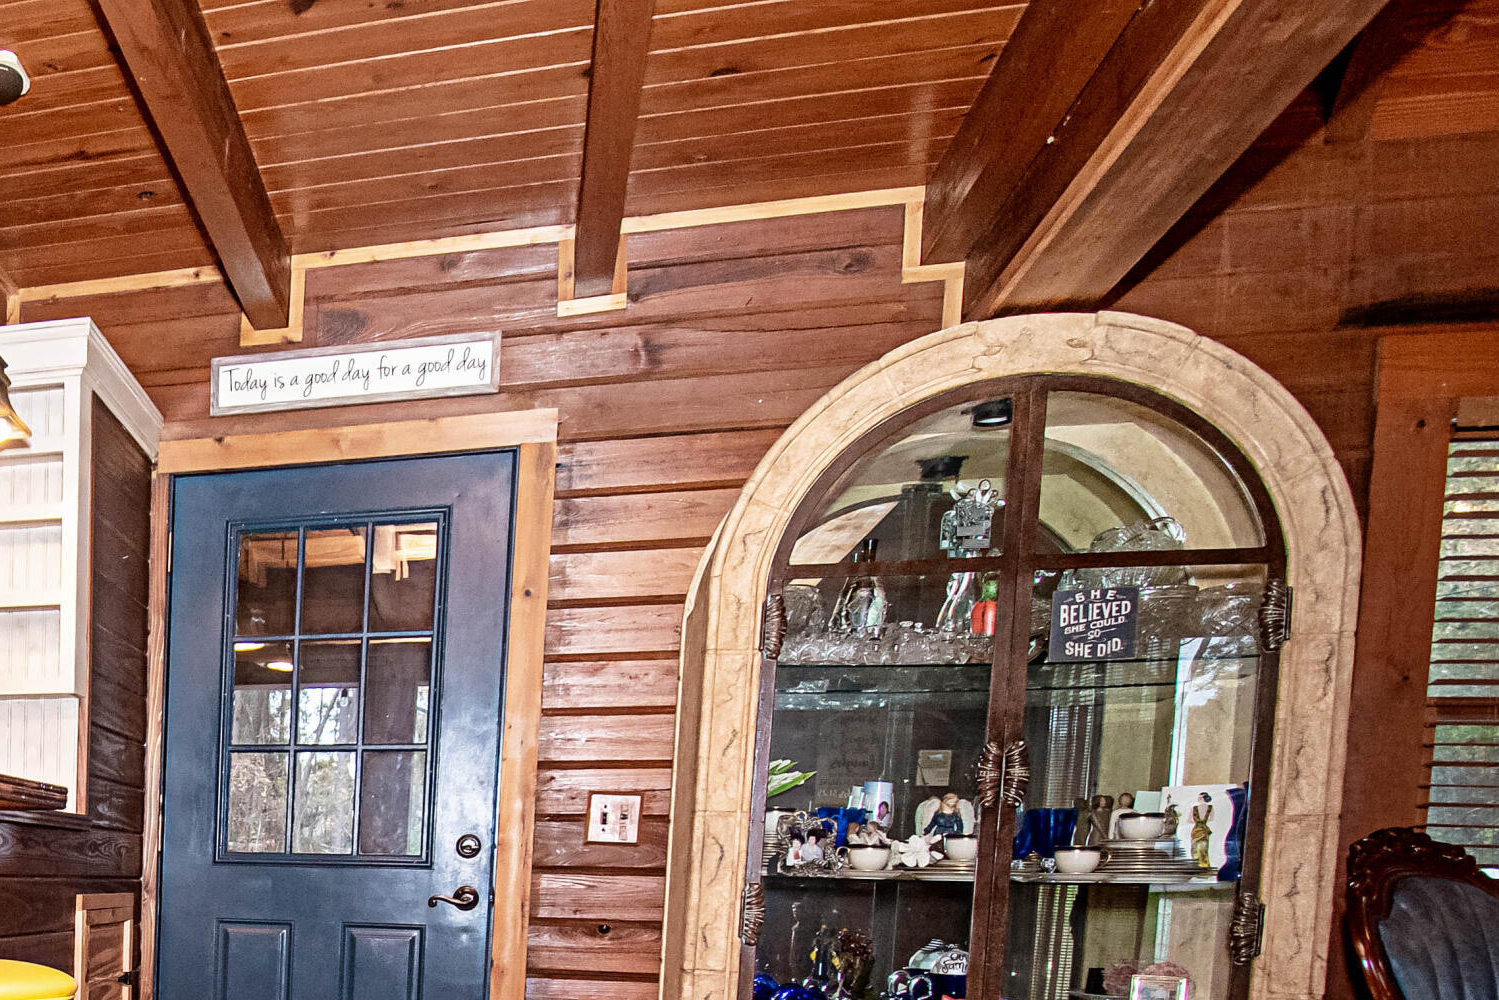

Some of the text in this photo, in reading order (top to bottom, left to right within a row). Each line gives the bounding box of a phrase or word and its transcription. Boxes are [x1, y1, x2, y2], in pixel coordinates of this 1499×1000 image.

[221, 346, 487, 400] Today is a good day for a good day
[1074, 589, 1117, 603] SHE
[1059, 600, 1132, 628] BELIEVED
[1064, 623, 1086, 635] SHE
[1087, 629, 1101, 640] SO
[1065, 641, 1093, 658] SHE
